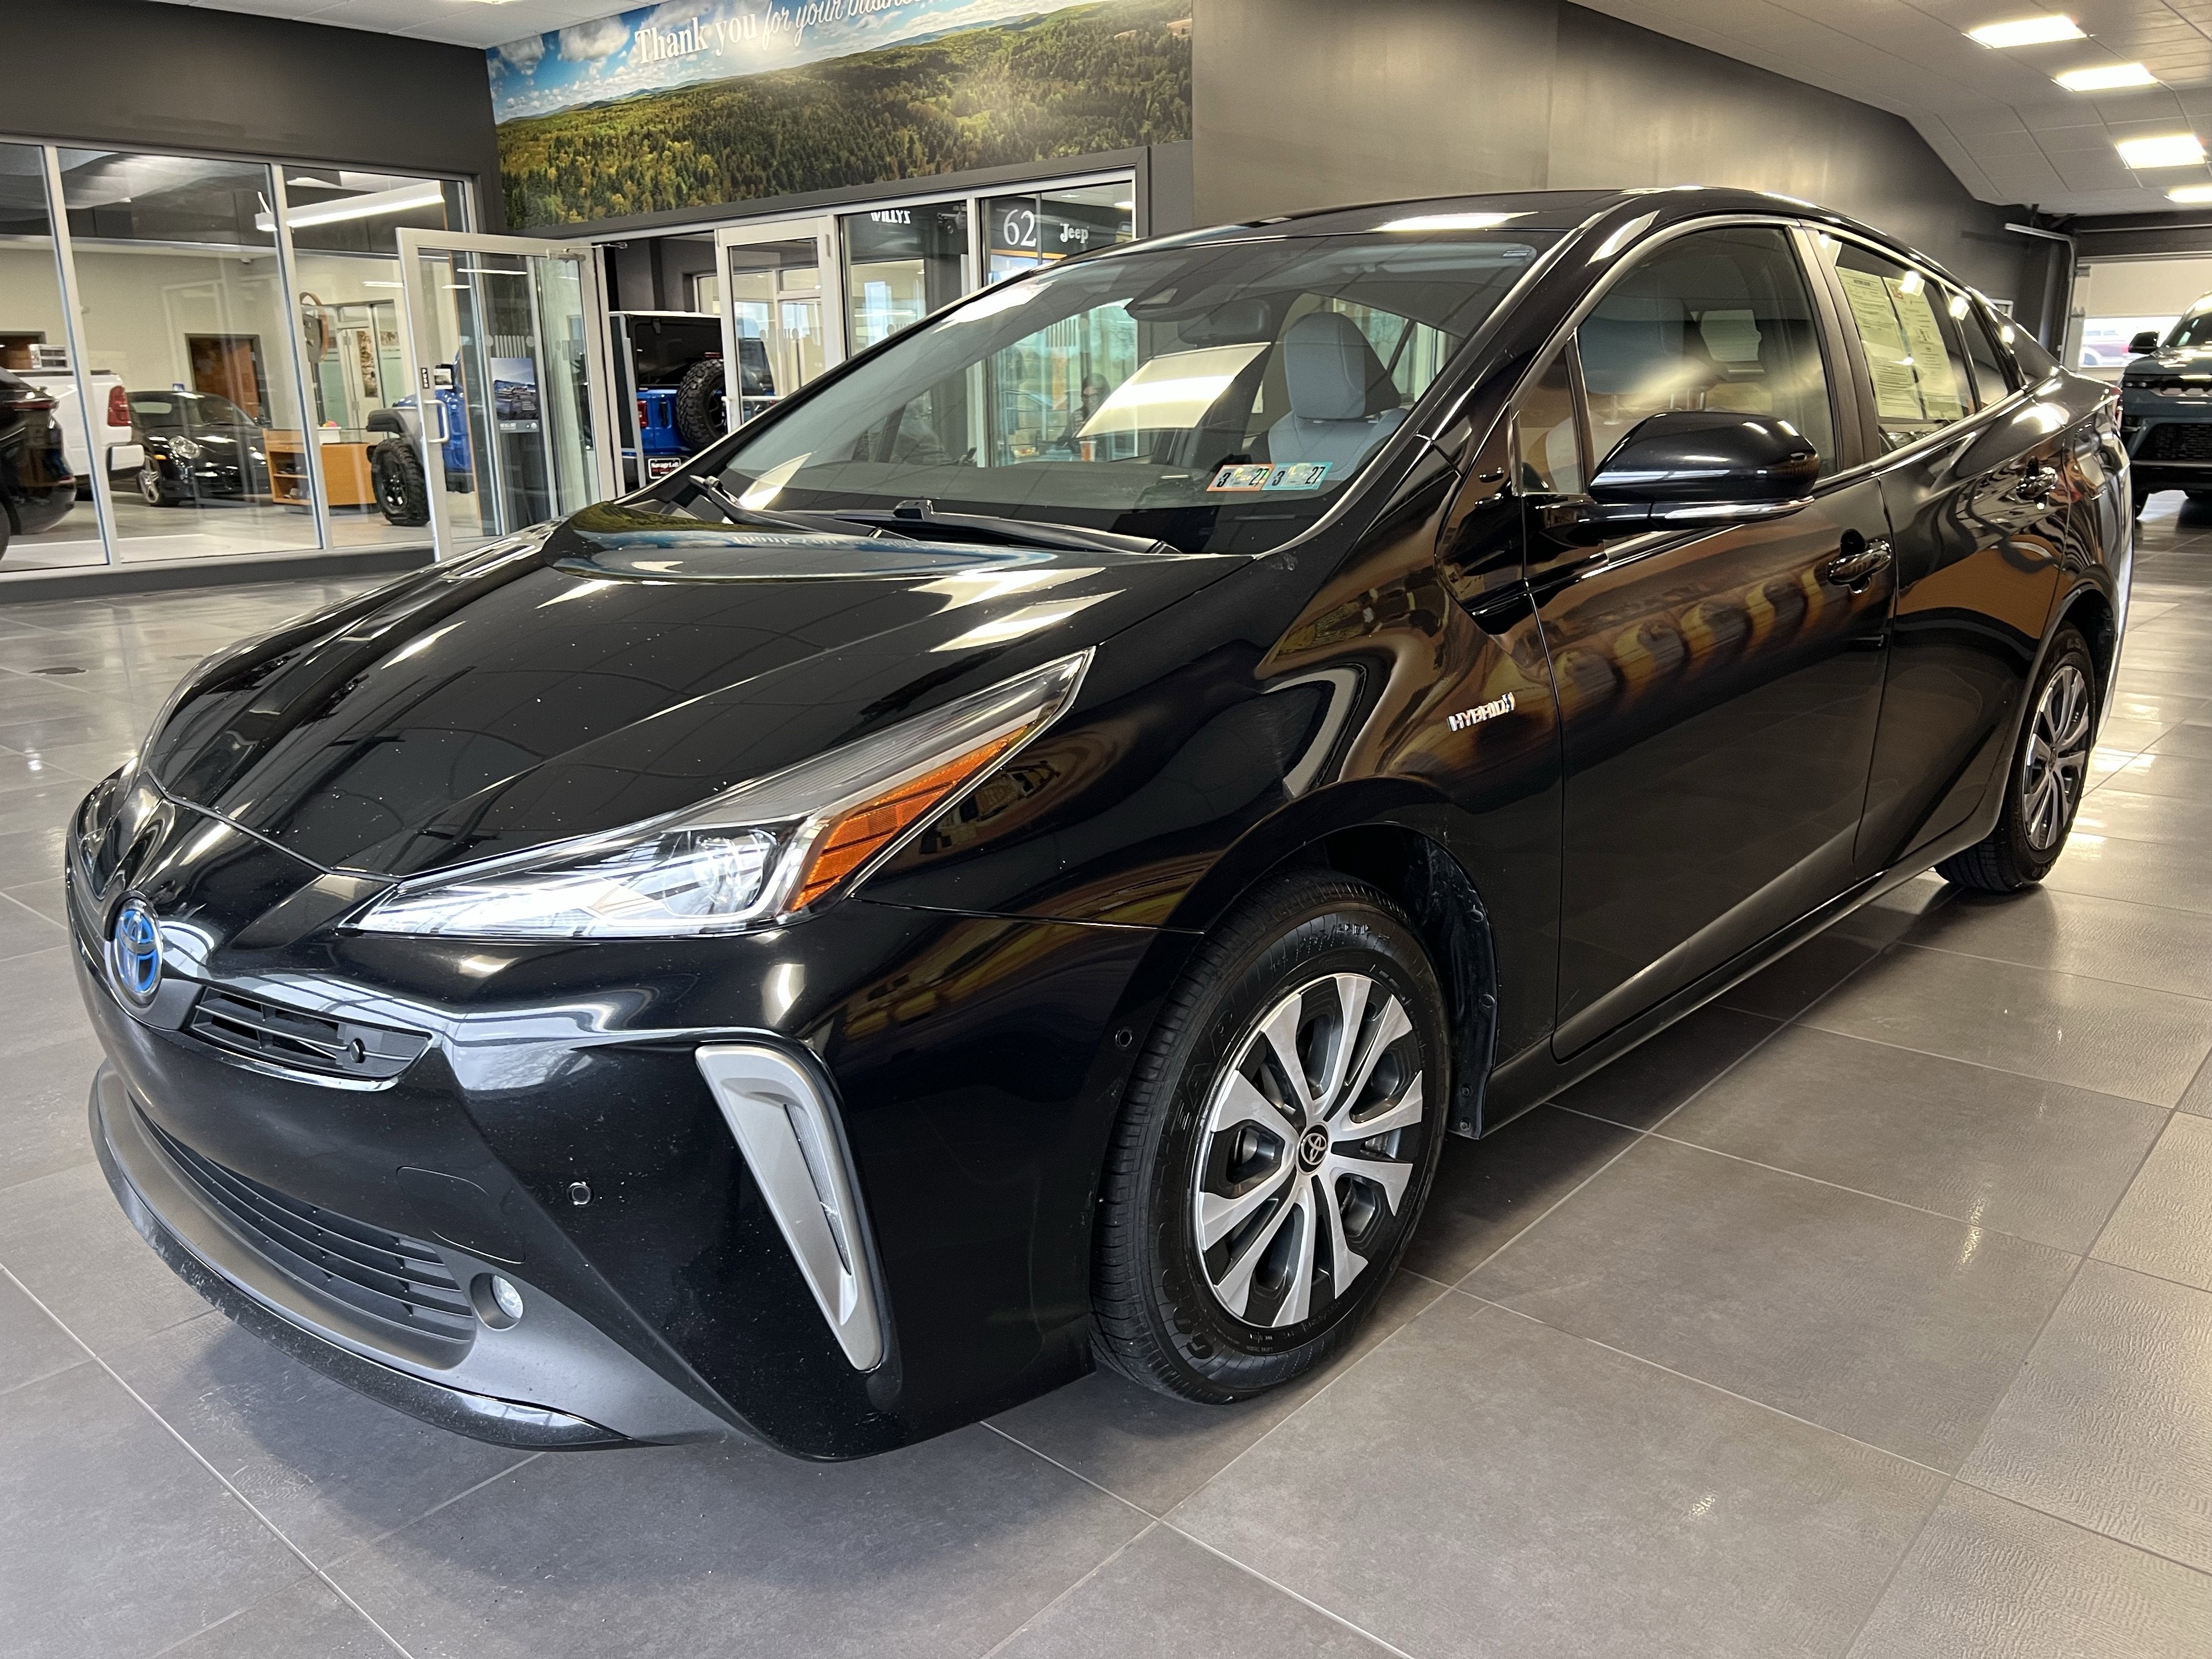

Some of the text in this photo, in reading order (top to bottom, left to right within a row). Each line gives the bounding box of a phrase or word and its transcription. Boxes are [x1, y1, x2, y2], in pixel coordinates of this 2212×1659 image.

[634, 17, 708, 64] Thank
[715, 14, 758, 56] you
[762, 1, 792, 51] for
[795, 0, 843, 47] your
[871, 210, 911, 224] WILLYS
[1003, 209, 1036, 247] 62
[1060, 223, 1089, 244] Jeep
[1216, 472, 1231, 487] 3
[1271, 470, 1285, 486] 3
[1447, 698, 1510, 731] HYBRID
